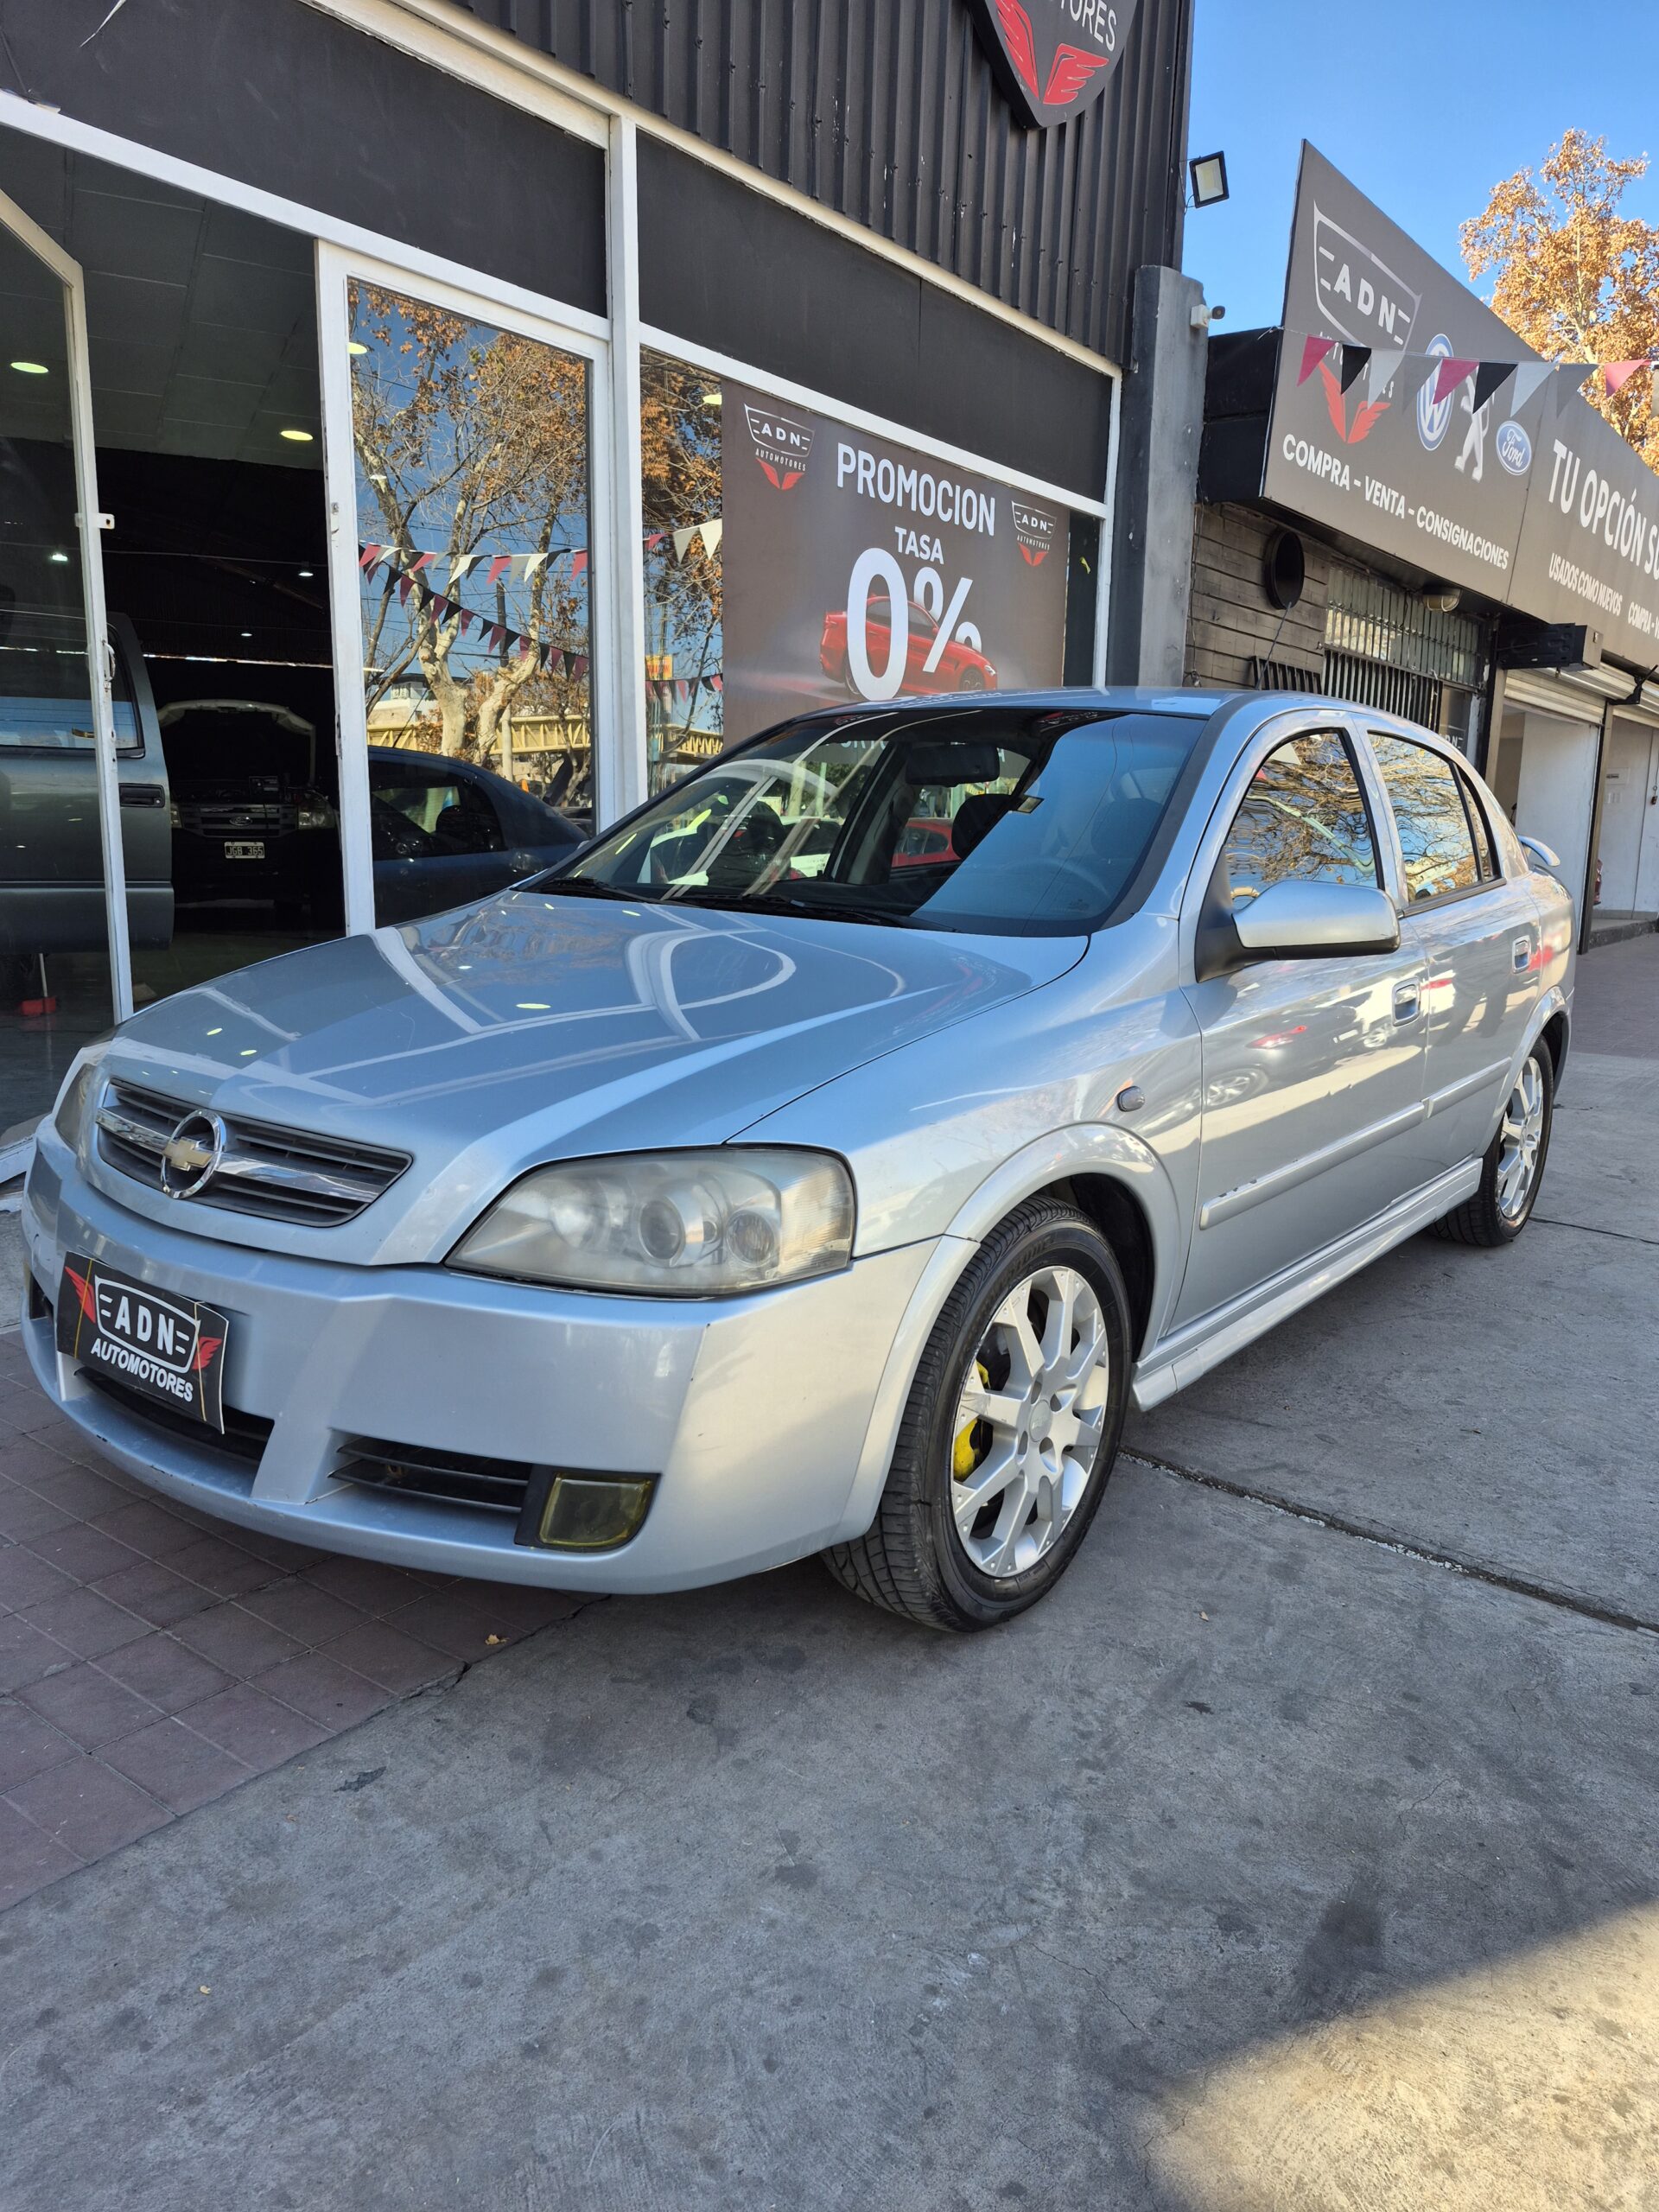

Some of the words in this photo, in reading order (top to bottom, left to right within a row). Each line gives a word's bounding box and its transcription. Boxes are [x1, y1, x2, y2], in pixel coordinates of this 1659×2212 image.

[1333, 263, 1396, 334] ADN
[755, 448, 806, 472] AUTOMOTORES
[761, 423, 800, 447] ADN
[836, 442, 995, 537] PROMOCION
[1282, 434, 1350, 491] COMPRA
[1364, 475, 1406, 519] VENTA
[1416, 505, 1510, 570] CONSIGNACIONES
[1548, 438, 1580, 514] TU
[1580, 469, 1647, 566] OPCIÓN
[894, 526, 944, 565] TASA
[1021, 514, 1047, 531] ADN
[1548, 552, 1580, 592] USADOS
[1577, 570, 1599, 603] COMO
[1597, 582, 1623, 616] NUEVOS
[847, 547, 982, 702] 0%
[1627, 601, 1651, 635] COMPRA
[248, 846, 263, 855] 365
[114, 1296, 175, 1355] ADN
[91, 1338, 194, 1402] AUTOMOTORES
